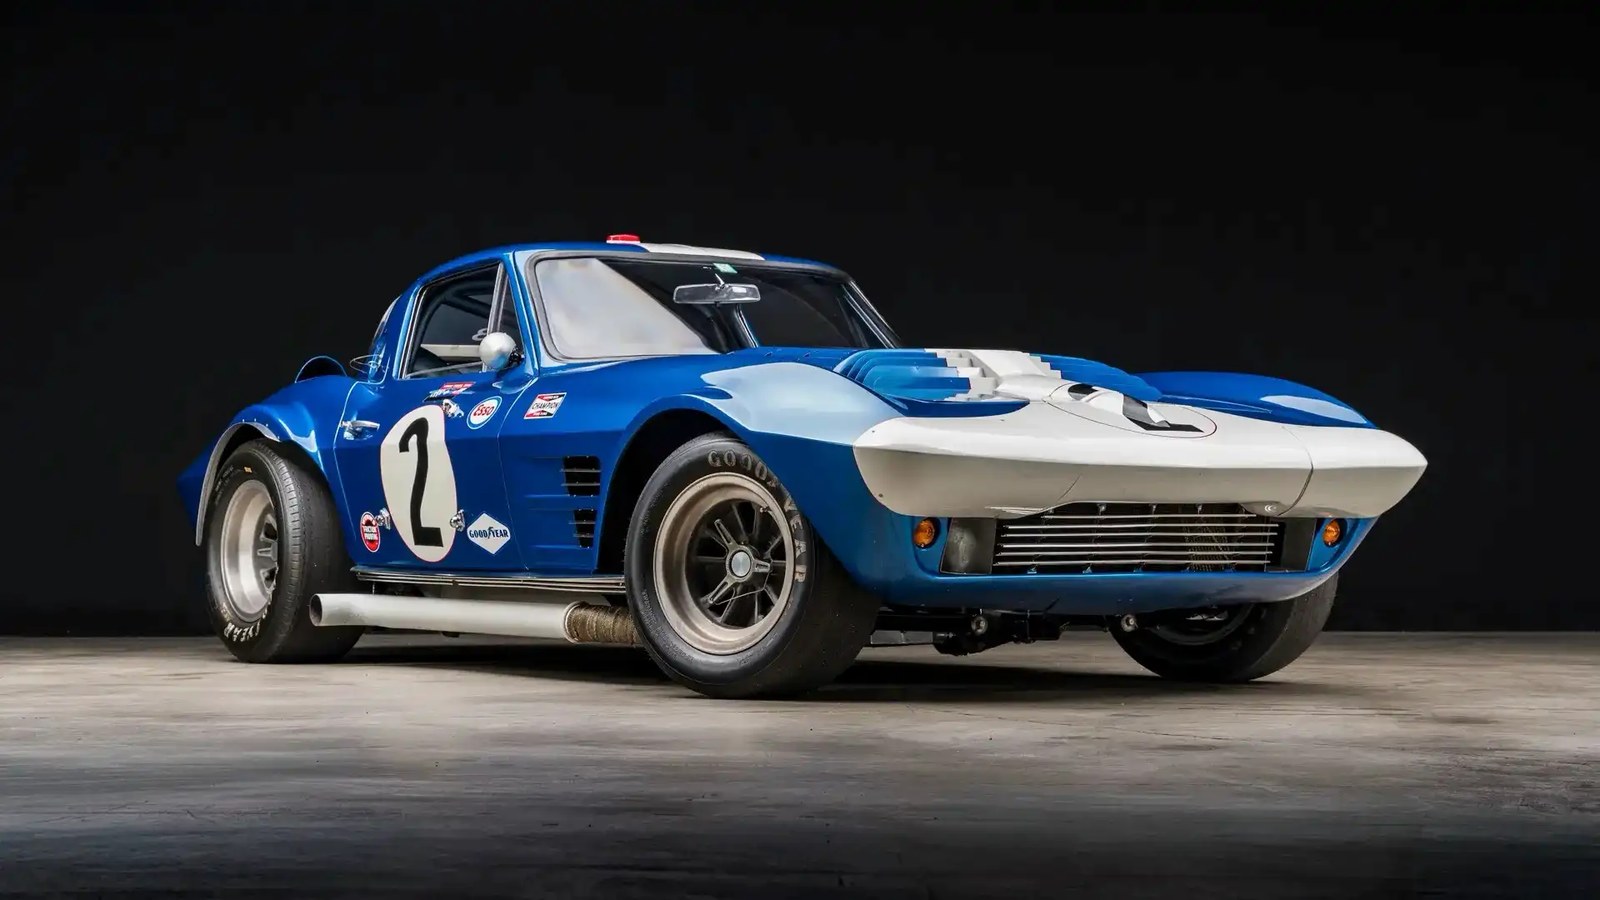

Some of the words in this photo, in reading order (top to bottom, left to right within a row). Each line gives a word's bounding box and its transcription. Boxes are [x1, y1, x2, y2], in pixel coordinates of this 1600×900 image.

[473, 403, 495, 417] Esso
[531, 401, 560, 410] CHAMPION
[399, 417, 443, 547] 2
